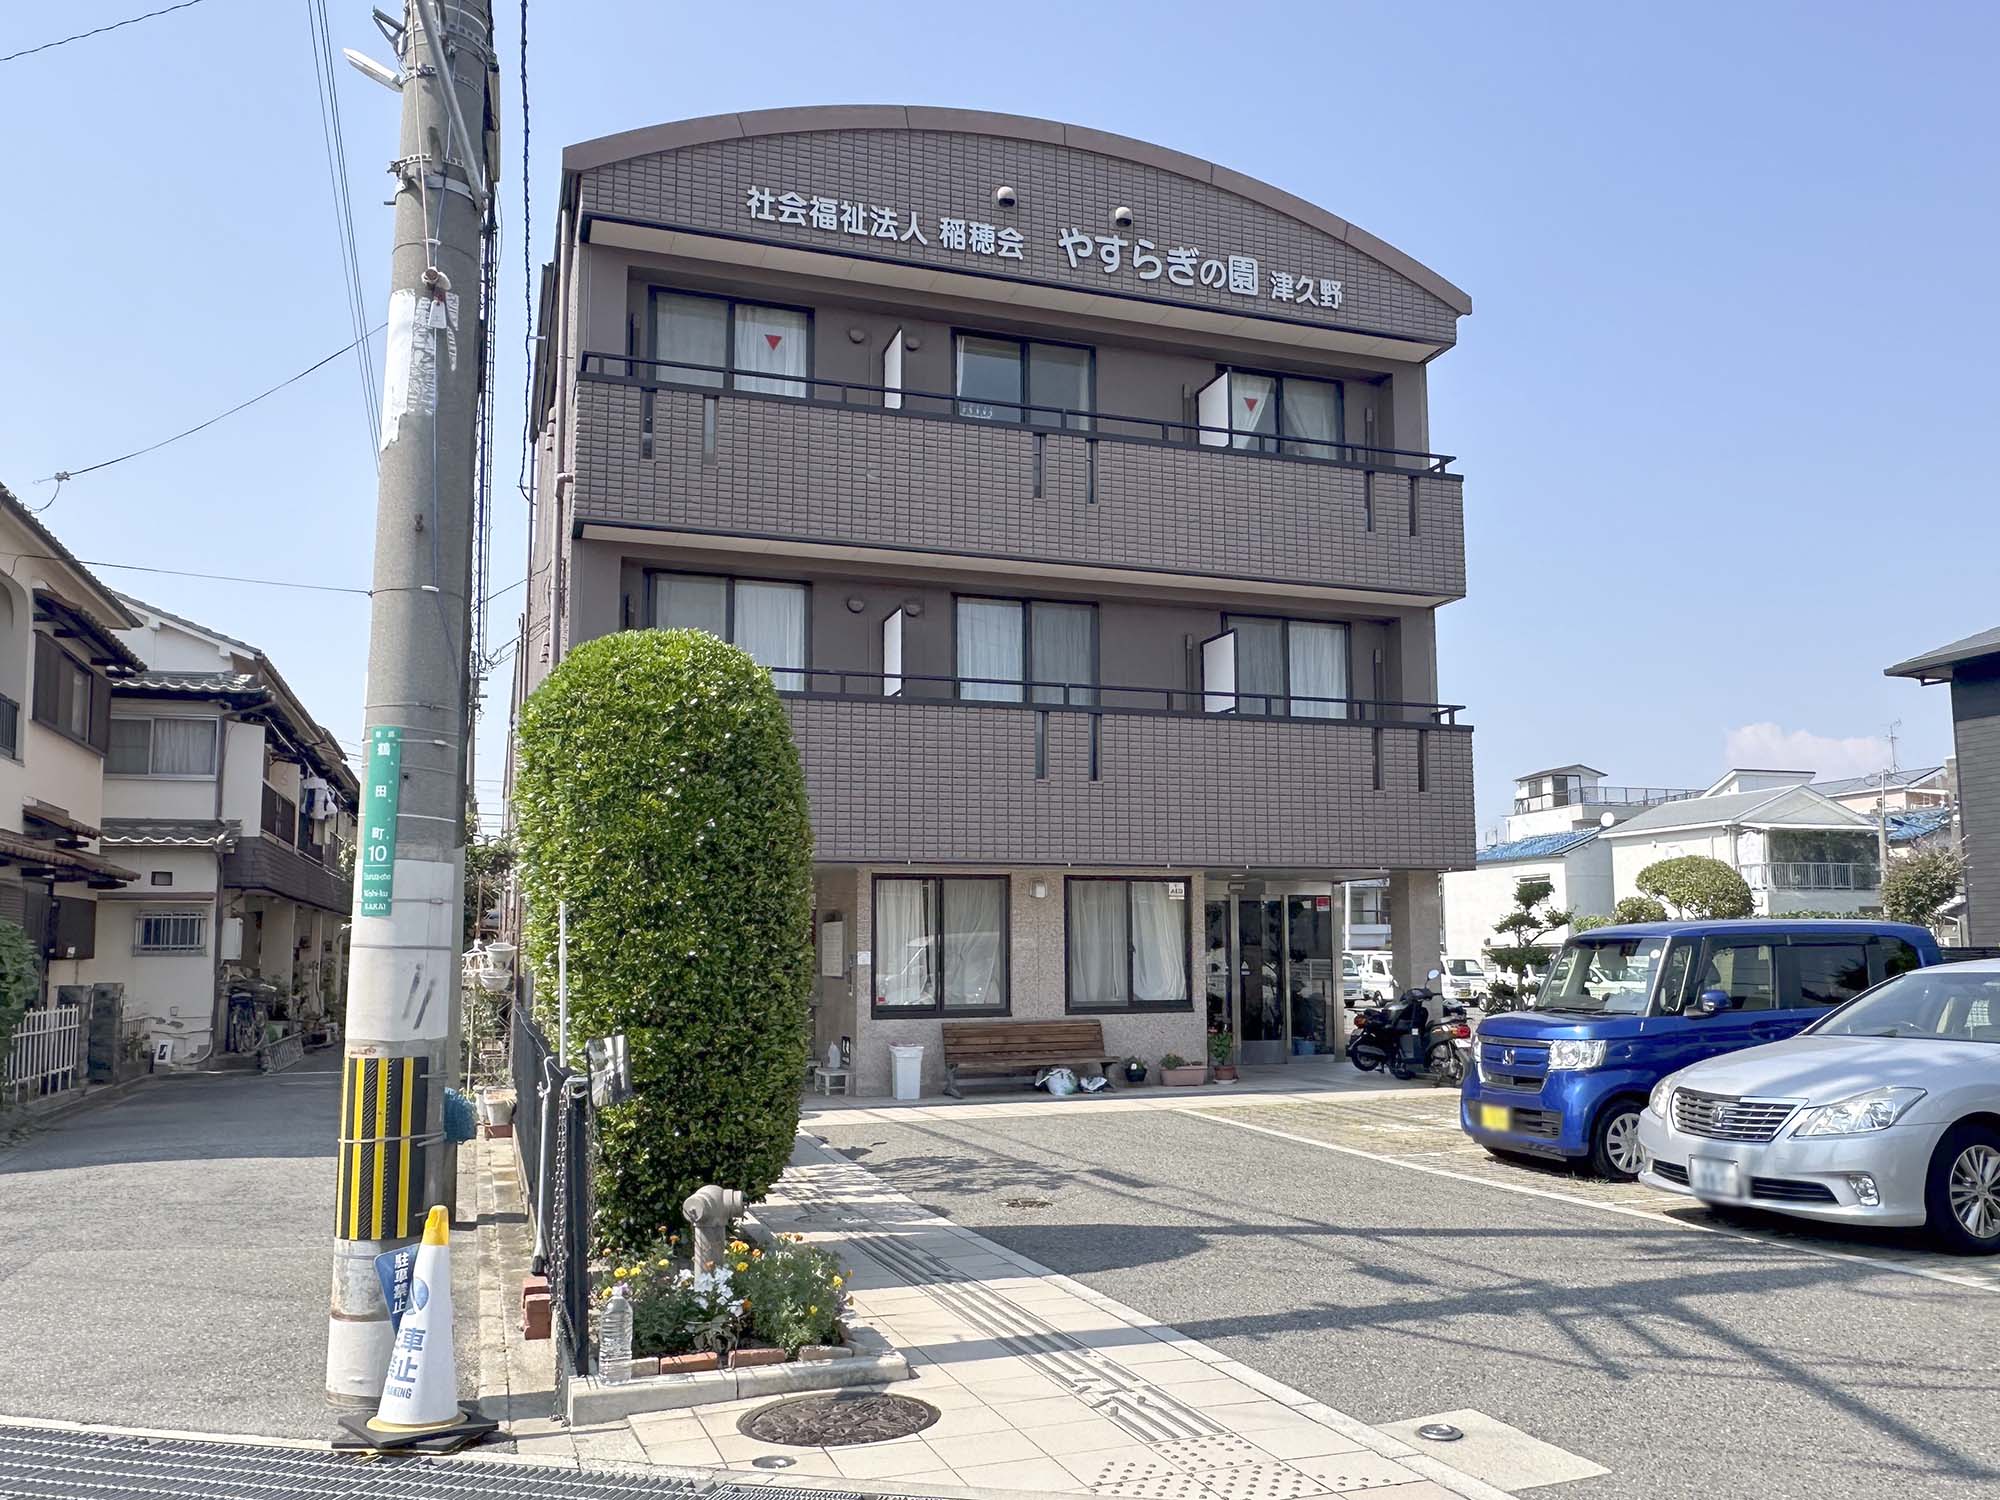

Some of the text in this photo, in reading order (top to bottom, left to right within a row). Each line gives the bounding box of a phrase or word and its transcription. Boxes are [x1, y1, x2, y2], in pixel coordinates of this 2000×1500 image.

[747, 185, 1343, 310] 社会福祉法人 稲穂会 やすらぎの園 津久野
[368, 845, 387, 862] 10
[392, 1251, 410, 1314] 駐車禁止
